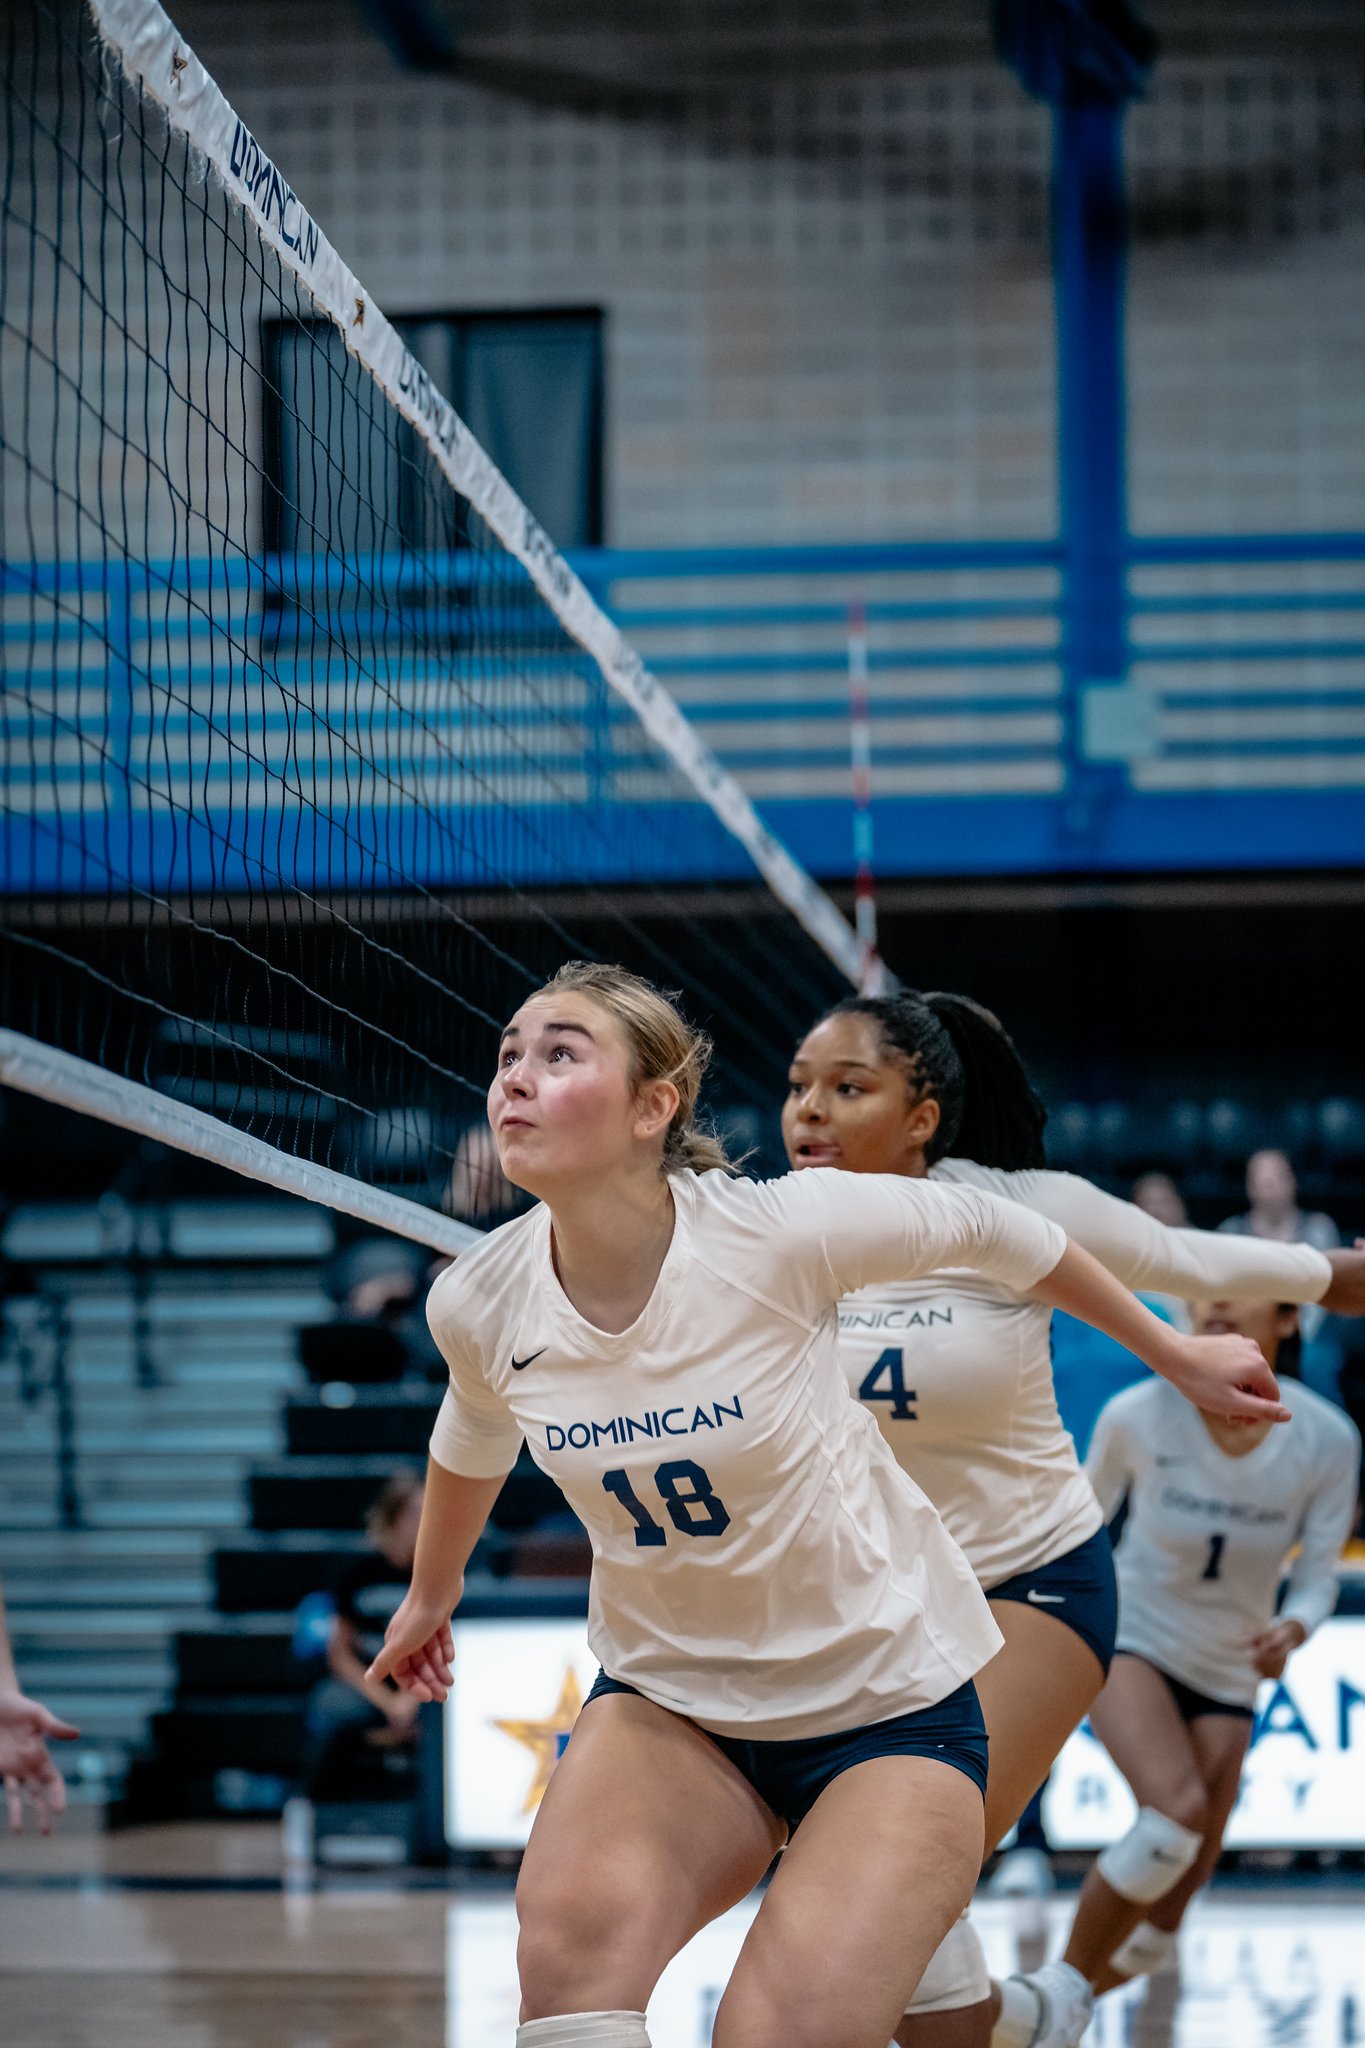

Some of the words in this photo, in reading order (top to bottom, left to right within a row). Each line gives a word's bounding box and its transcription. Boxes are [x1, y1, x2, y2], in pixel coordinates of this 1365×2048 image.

[858, 1347, 918, 1420] 4
[545, 1395, 744, 1451] DOMINICAN
[601, 1459, 731, 1546] 18
[1203, 1533, 1225, 1580] 1
